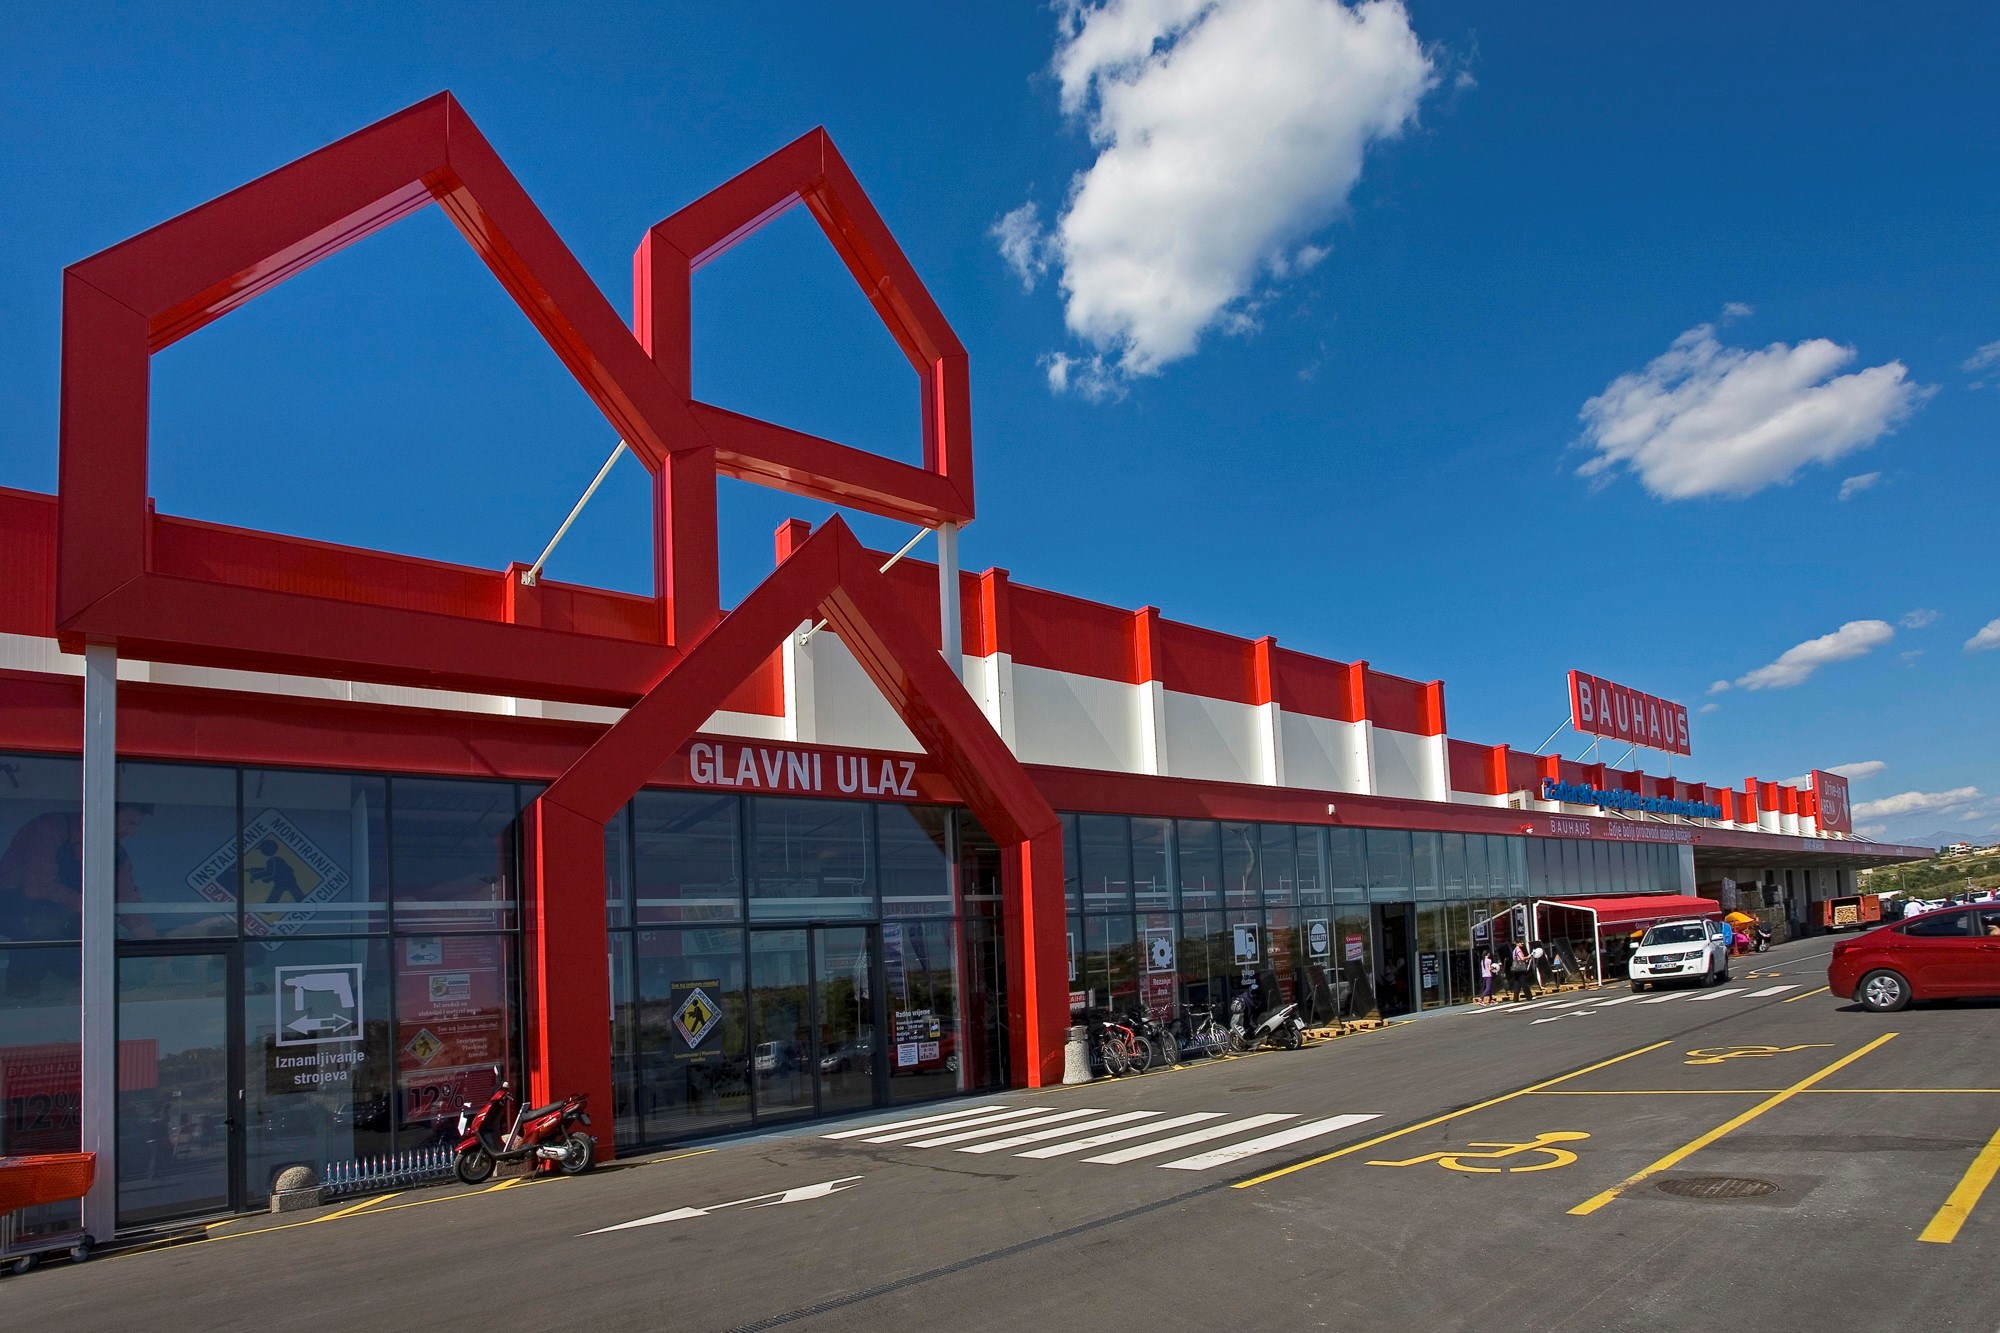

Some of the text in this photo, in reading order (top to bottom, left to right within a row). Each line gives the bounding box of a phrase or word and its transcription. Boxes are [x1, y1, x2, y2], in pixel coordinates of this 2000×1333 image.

[1578, 680, 1688, 746] BAUHAUS
[690, 743, 918, 797] GLAVNI ULAZ
[1550, 820, 1591, 835] BAUHAUS
[270, 818, 336, 877] MONTIRANJE
[204, 884, 267, 936] BAAUS
[1310, 934, 1327, 943] QUALITY
[1152, 977, 1172, 987] Rezanje
[912, 1009, 931, 1017] vrijeme
[275, 1050, 365, 1068] Iznamljivanje
[8, 1062, 82, 1077] BAUHAU
[294, 1070, 348, 1085] strojeva
[411, 1081, 465, 1114] 12%
[11, 1088, 82, 1133] 12%
